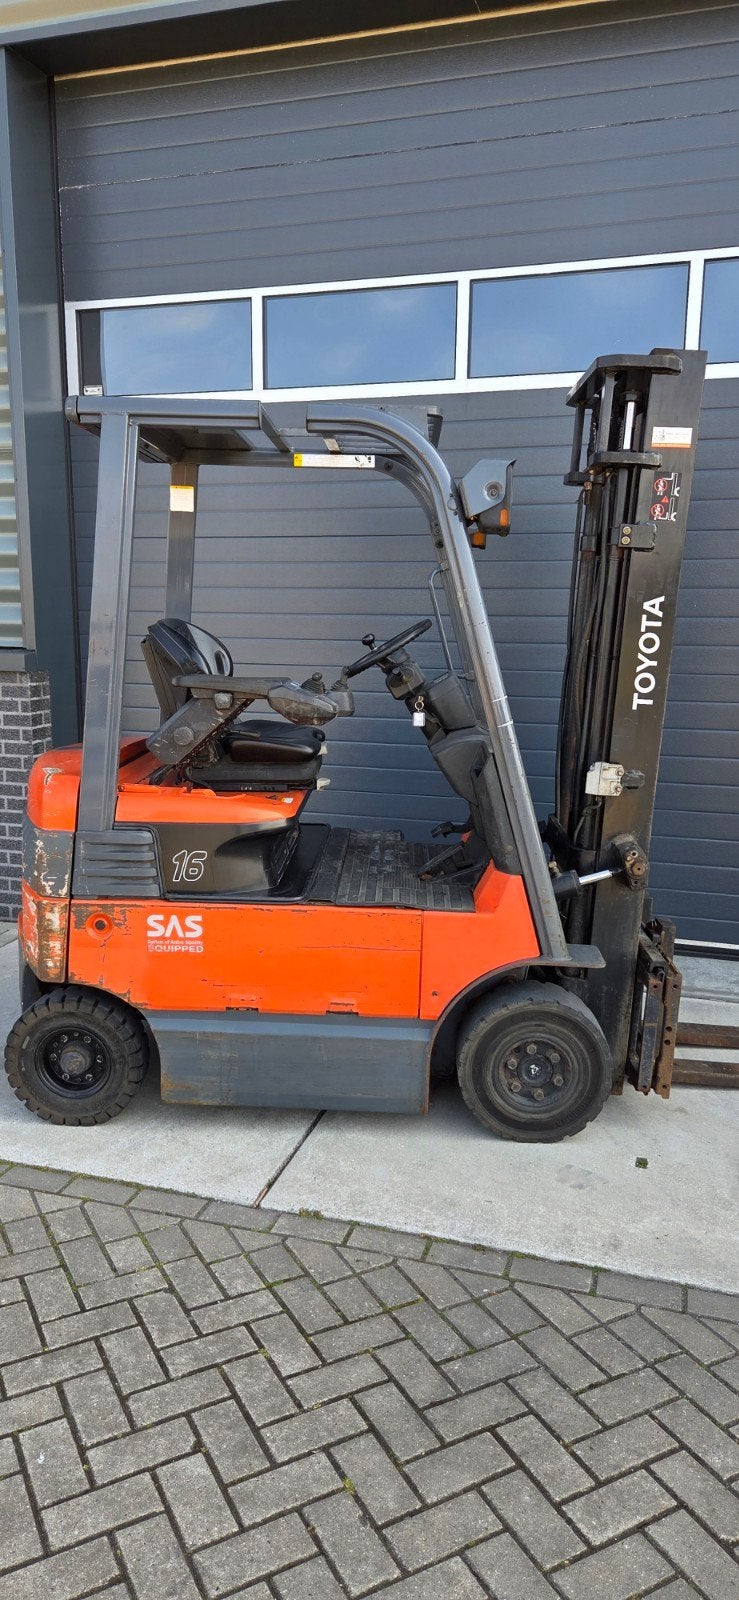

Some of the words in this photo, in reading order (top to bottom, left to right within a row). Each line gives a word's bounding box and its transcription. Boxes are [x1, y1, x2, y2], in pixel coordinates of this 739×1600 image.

[632, 595, 665, 711] TOYOTA
[172, 850, 208, 882] 16
[147, 914, 203, 938] SAS
[147, 945, 204, 953] EQUIPPED
